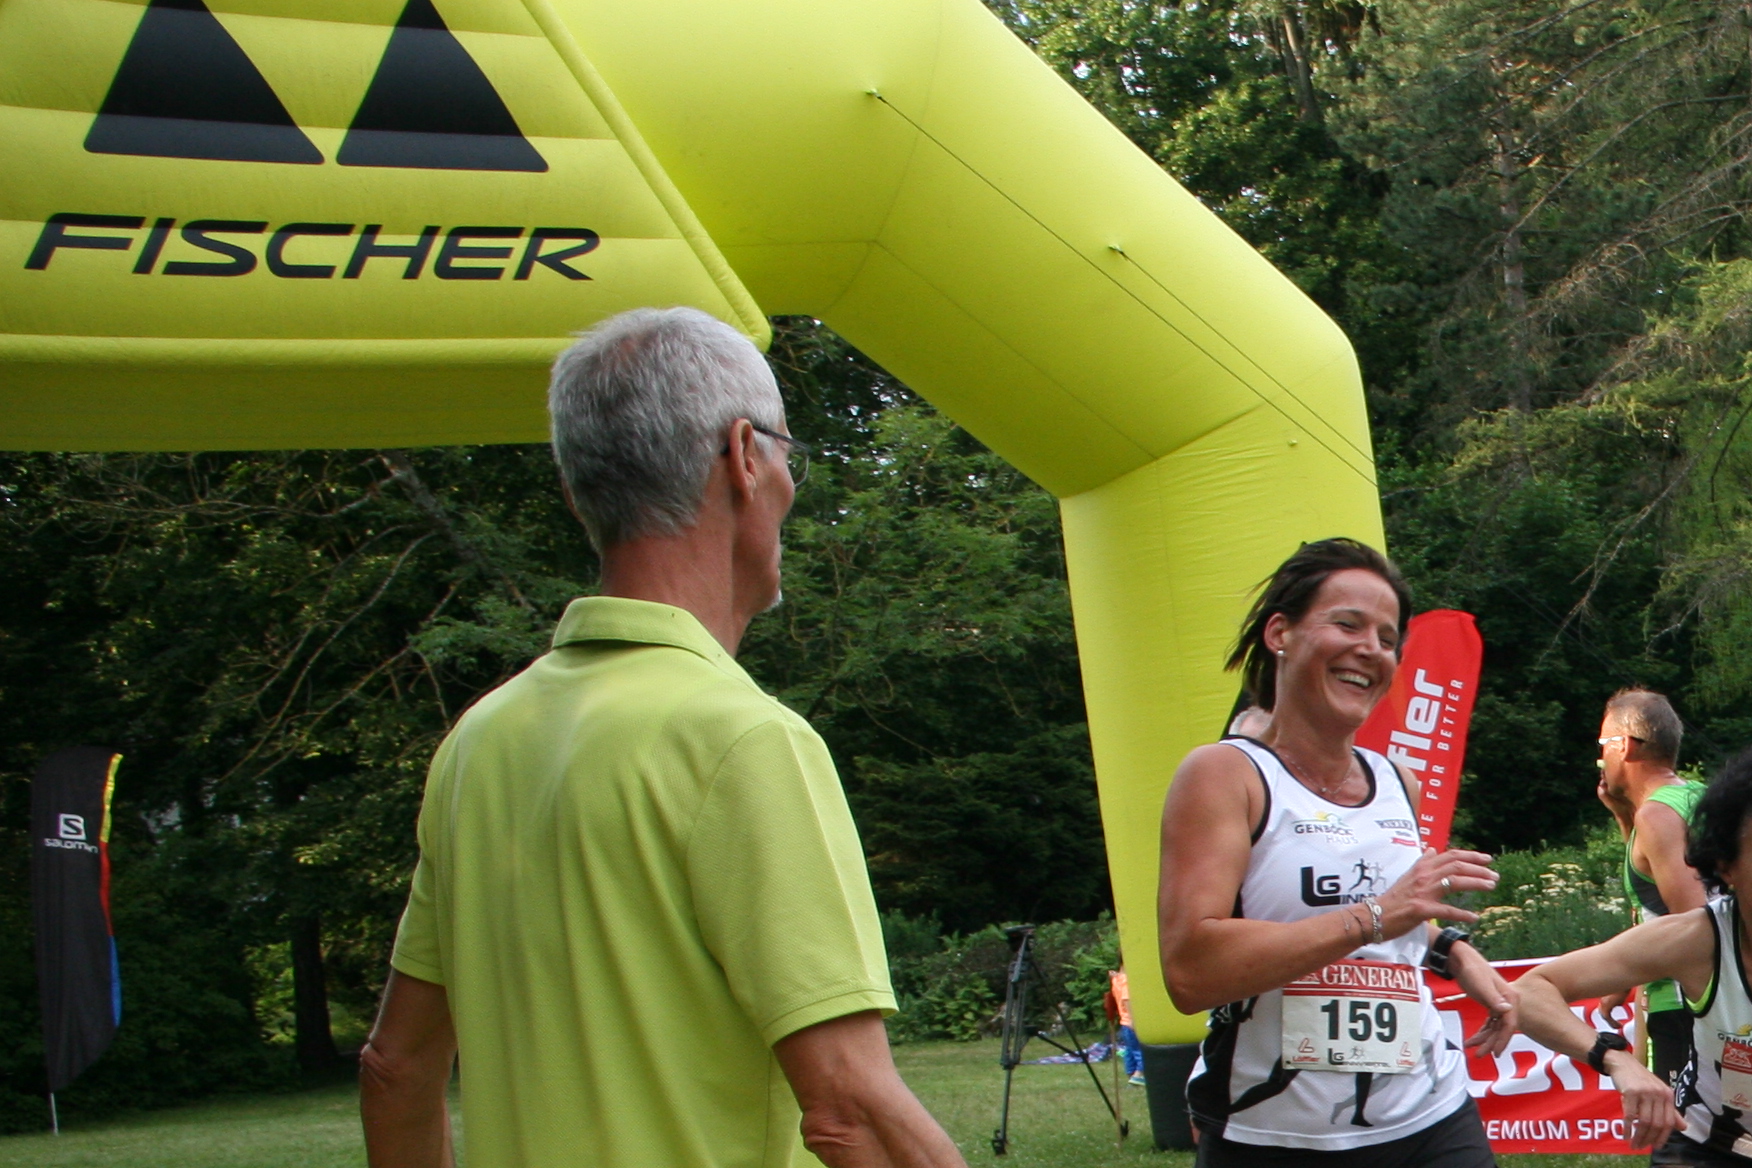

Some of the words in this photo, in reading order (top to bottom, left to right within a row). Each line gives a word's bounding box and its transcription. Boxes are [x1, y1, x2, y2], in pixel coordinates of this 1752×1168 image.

[24, 212, 601, 281] FISCHER
[1426, 764, 1446, 800] FOR
[1436, 679, 1465, 751] BETTER
[1320, 999, 1397, 1043] 159
[1482, 1119, 1570, 1141] EMIUM
